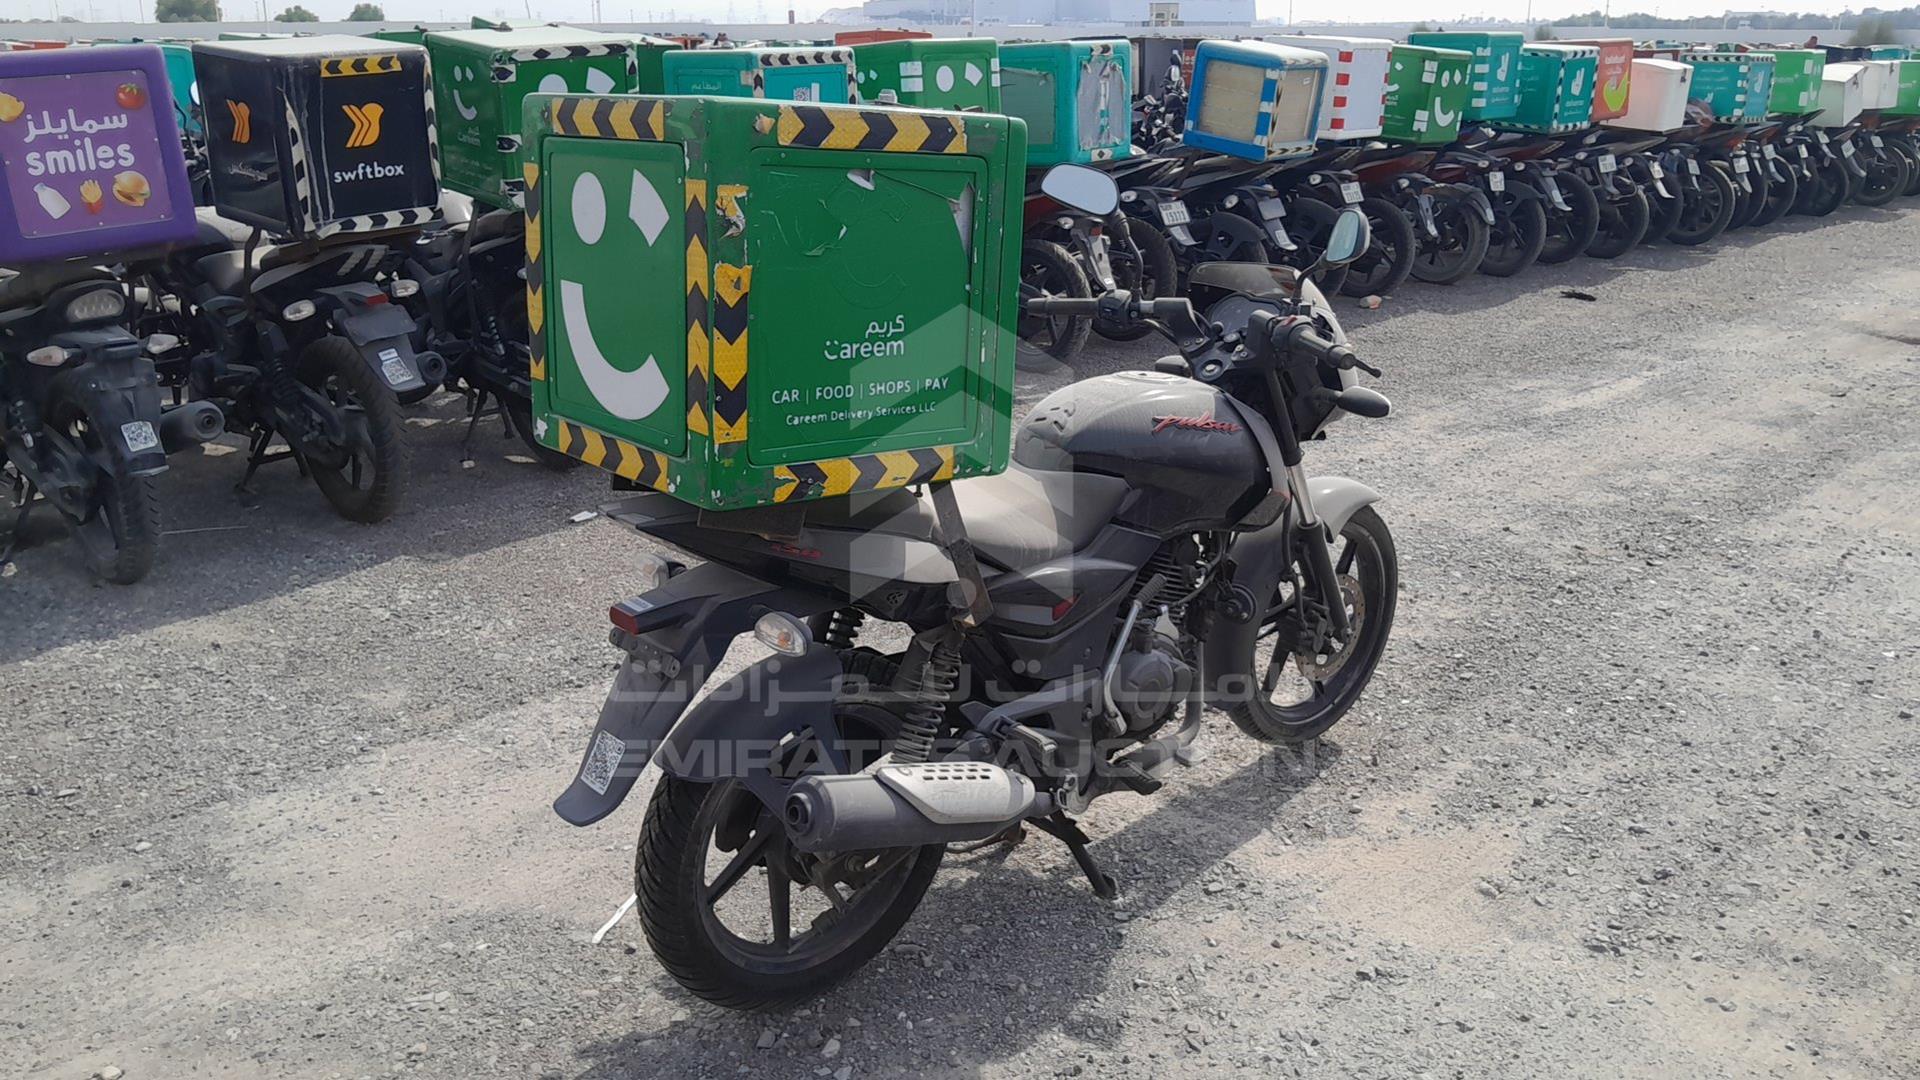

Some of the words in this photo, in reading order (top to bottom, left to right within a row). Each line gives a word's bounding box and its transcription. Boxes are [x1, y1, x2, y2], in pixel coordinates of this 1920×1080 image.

[23, 108, 128, 143] سمايلز
[26, 137, 135, 176] smiles
[334, 161, 405, 184] swftbox
[865, 315, 905, 338] كريم
[824, 340, 904, 360] Careem
[772, 389, 800, 404] CAR
[816, 385, 854, 400] FOOD
[869, 380, 911, 396] SHOPS
[925, 377, 949, 391] PAY
[786, 411, 828, 425] Careem
[831, 408, 873, 420] Delivery
[876, 404, 916, 417] Services
[919, 401, 936, 412] LLC
